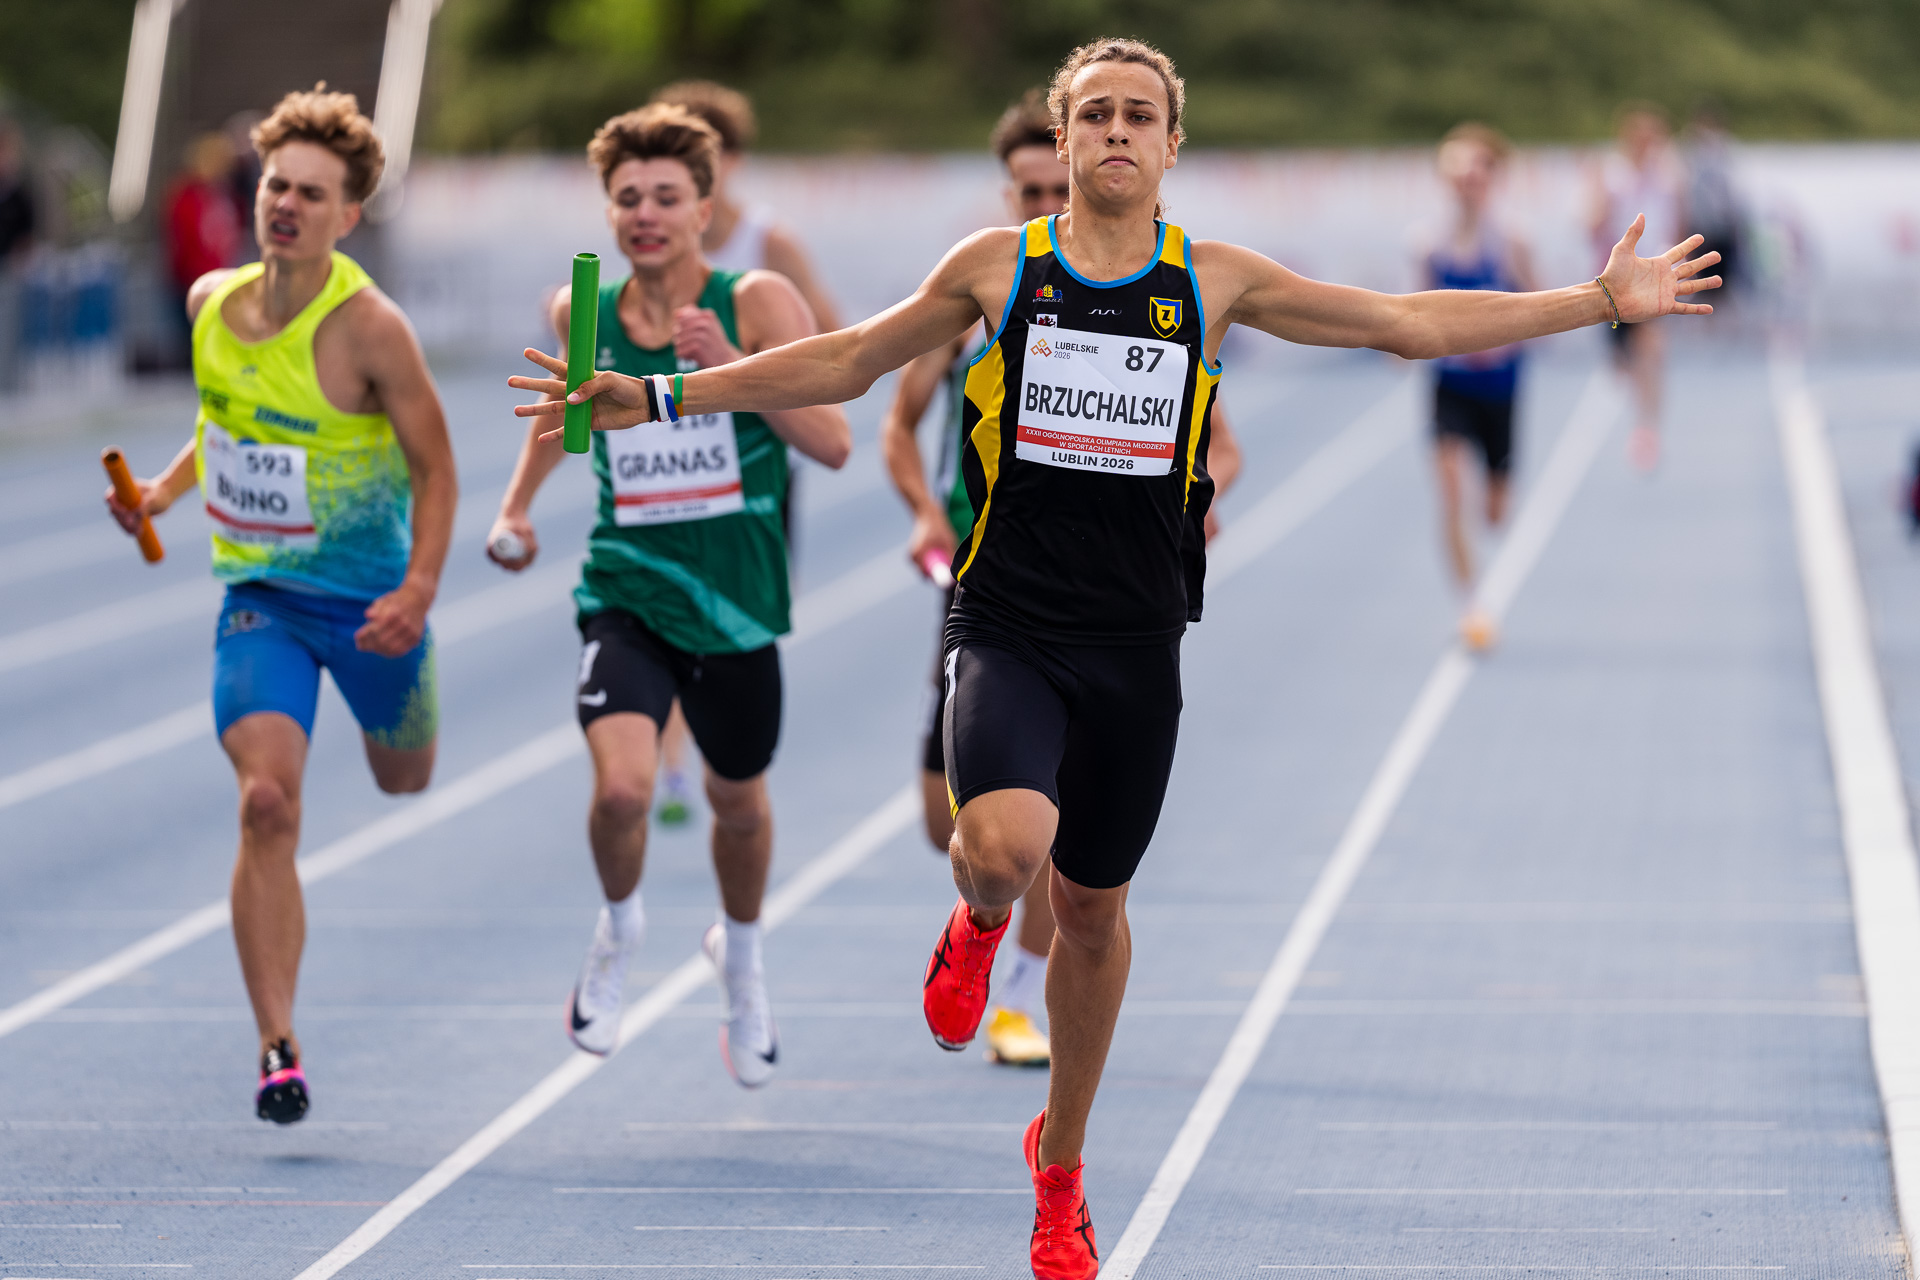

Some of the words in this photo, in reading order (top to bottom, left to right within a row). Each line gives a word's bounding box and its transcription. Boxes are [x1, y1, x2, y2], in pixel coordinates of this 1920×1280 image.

[1161, 309, 1171, 322] Z
[1054, 351, 1071, 360] 2026
[1055, 341, 1099, 355] LUBELSKIE
[1125, 345, 1165, 373] 87
[1025, 382, 1174, 427] BRZUCHALSKI
[1025, 428, 1041, 437] XXXII
[1042, 430, 1095, 444] OGÓLNOPOLSKA
[1096, 438, 1131, 448] OLIMPIADA
[1132, 442, 1167, 451] MŁODZIEŻY
[1067, 442, 1104, 452] SPORTACH
[1104, 446, 1131, 455] LETNICH
[246, 451, 292, 477] 593
[617, 445, 727, 480] GRANAS
[1051, 451, 1098, 467] LUBLIN
[1100, 457, 1134, 470] 2026
